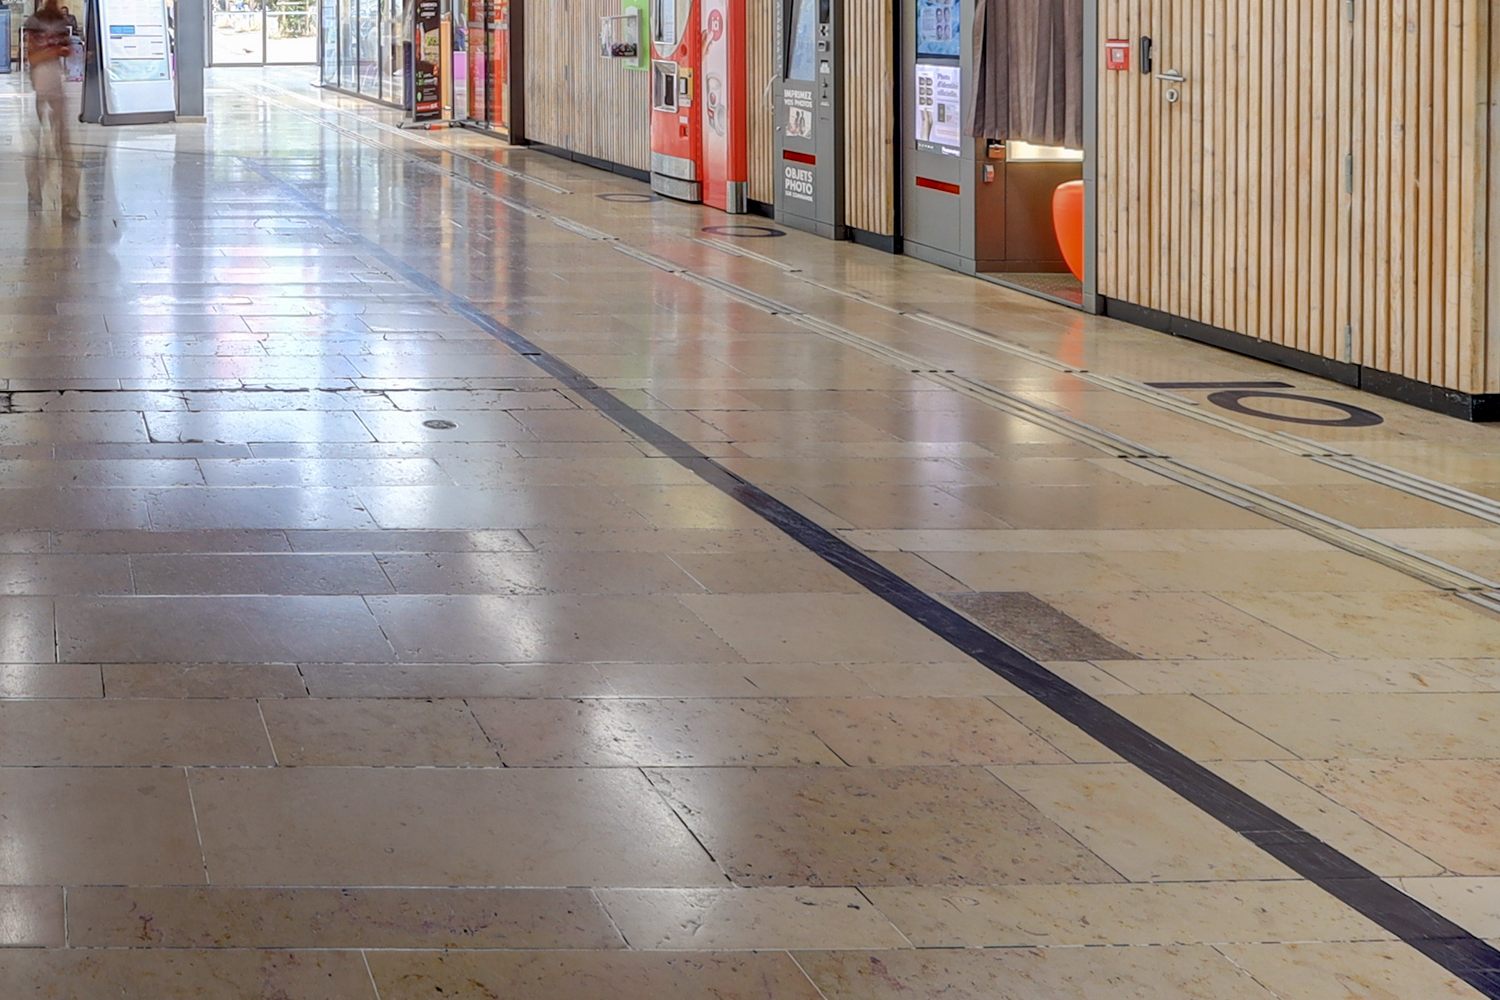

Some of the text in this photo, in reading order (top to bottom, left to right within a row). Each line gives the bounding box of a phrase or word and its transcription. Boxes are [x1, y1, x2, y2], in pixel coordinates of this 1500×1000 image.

[784, 89, 812, 100] IMPRIMEZ
[794, 100, 813, 108] PHOTOS
[785, 167, 812, 183] OBJETS
[785, 178, 813, 195] PHOTO
